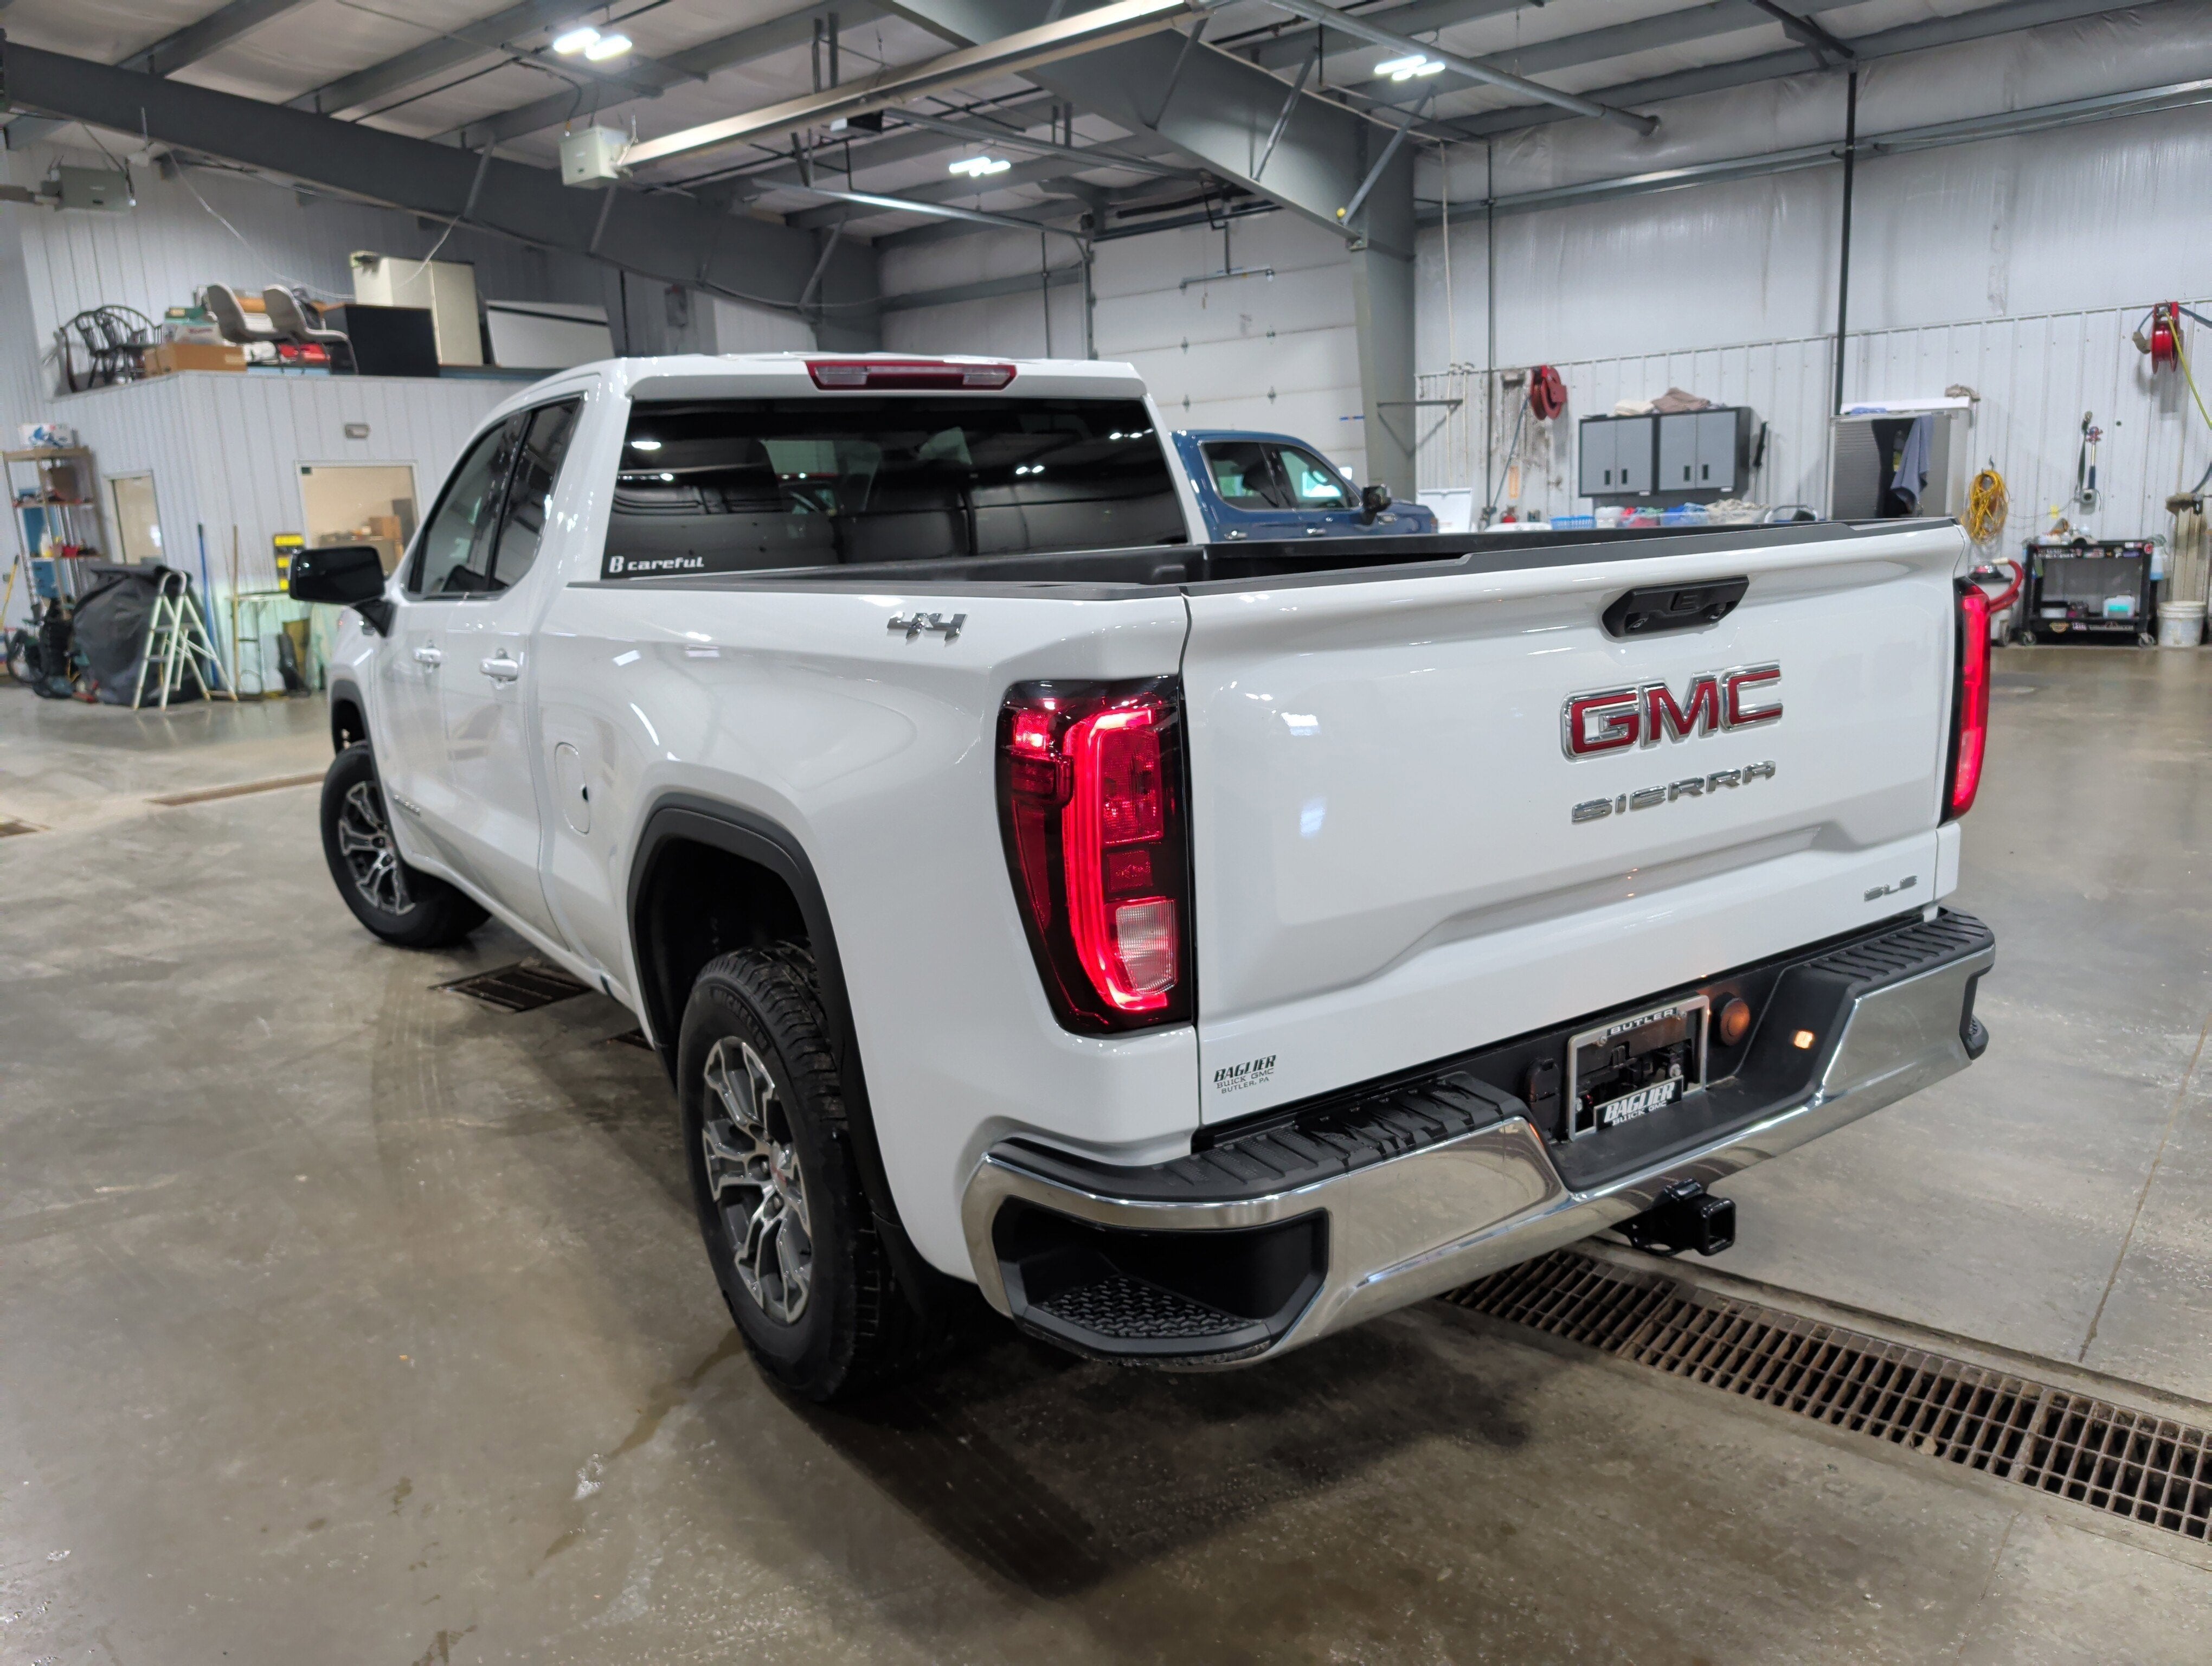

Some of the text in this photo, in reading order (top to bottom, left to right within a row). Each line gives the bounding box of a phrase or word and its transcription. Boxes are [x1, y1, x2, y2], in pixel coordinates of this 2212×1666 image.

[608, 555, 705, 573] B careful
[1560, 659, 1784, 762] GMC
[1571, 760, 1777, 825] SIERRA
[1863, 875, 1918, 901] SLE
[1610, 1008, 1675, 1035] BUTLER
[1213, 1054, 1277, 1082] BAGLIER
[1216, 1067, 1274, 1089] BUICK GMC
[1221, 1080, 1257, 1094] BUTLER,
[1603, 1081, 1675, 1123] BAGLIER
[1612, 1100, 1667, 1126] BUICK GMC
